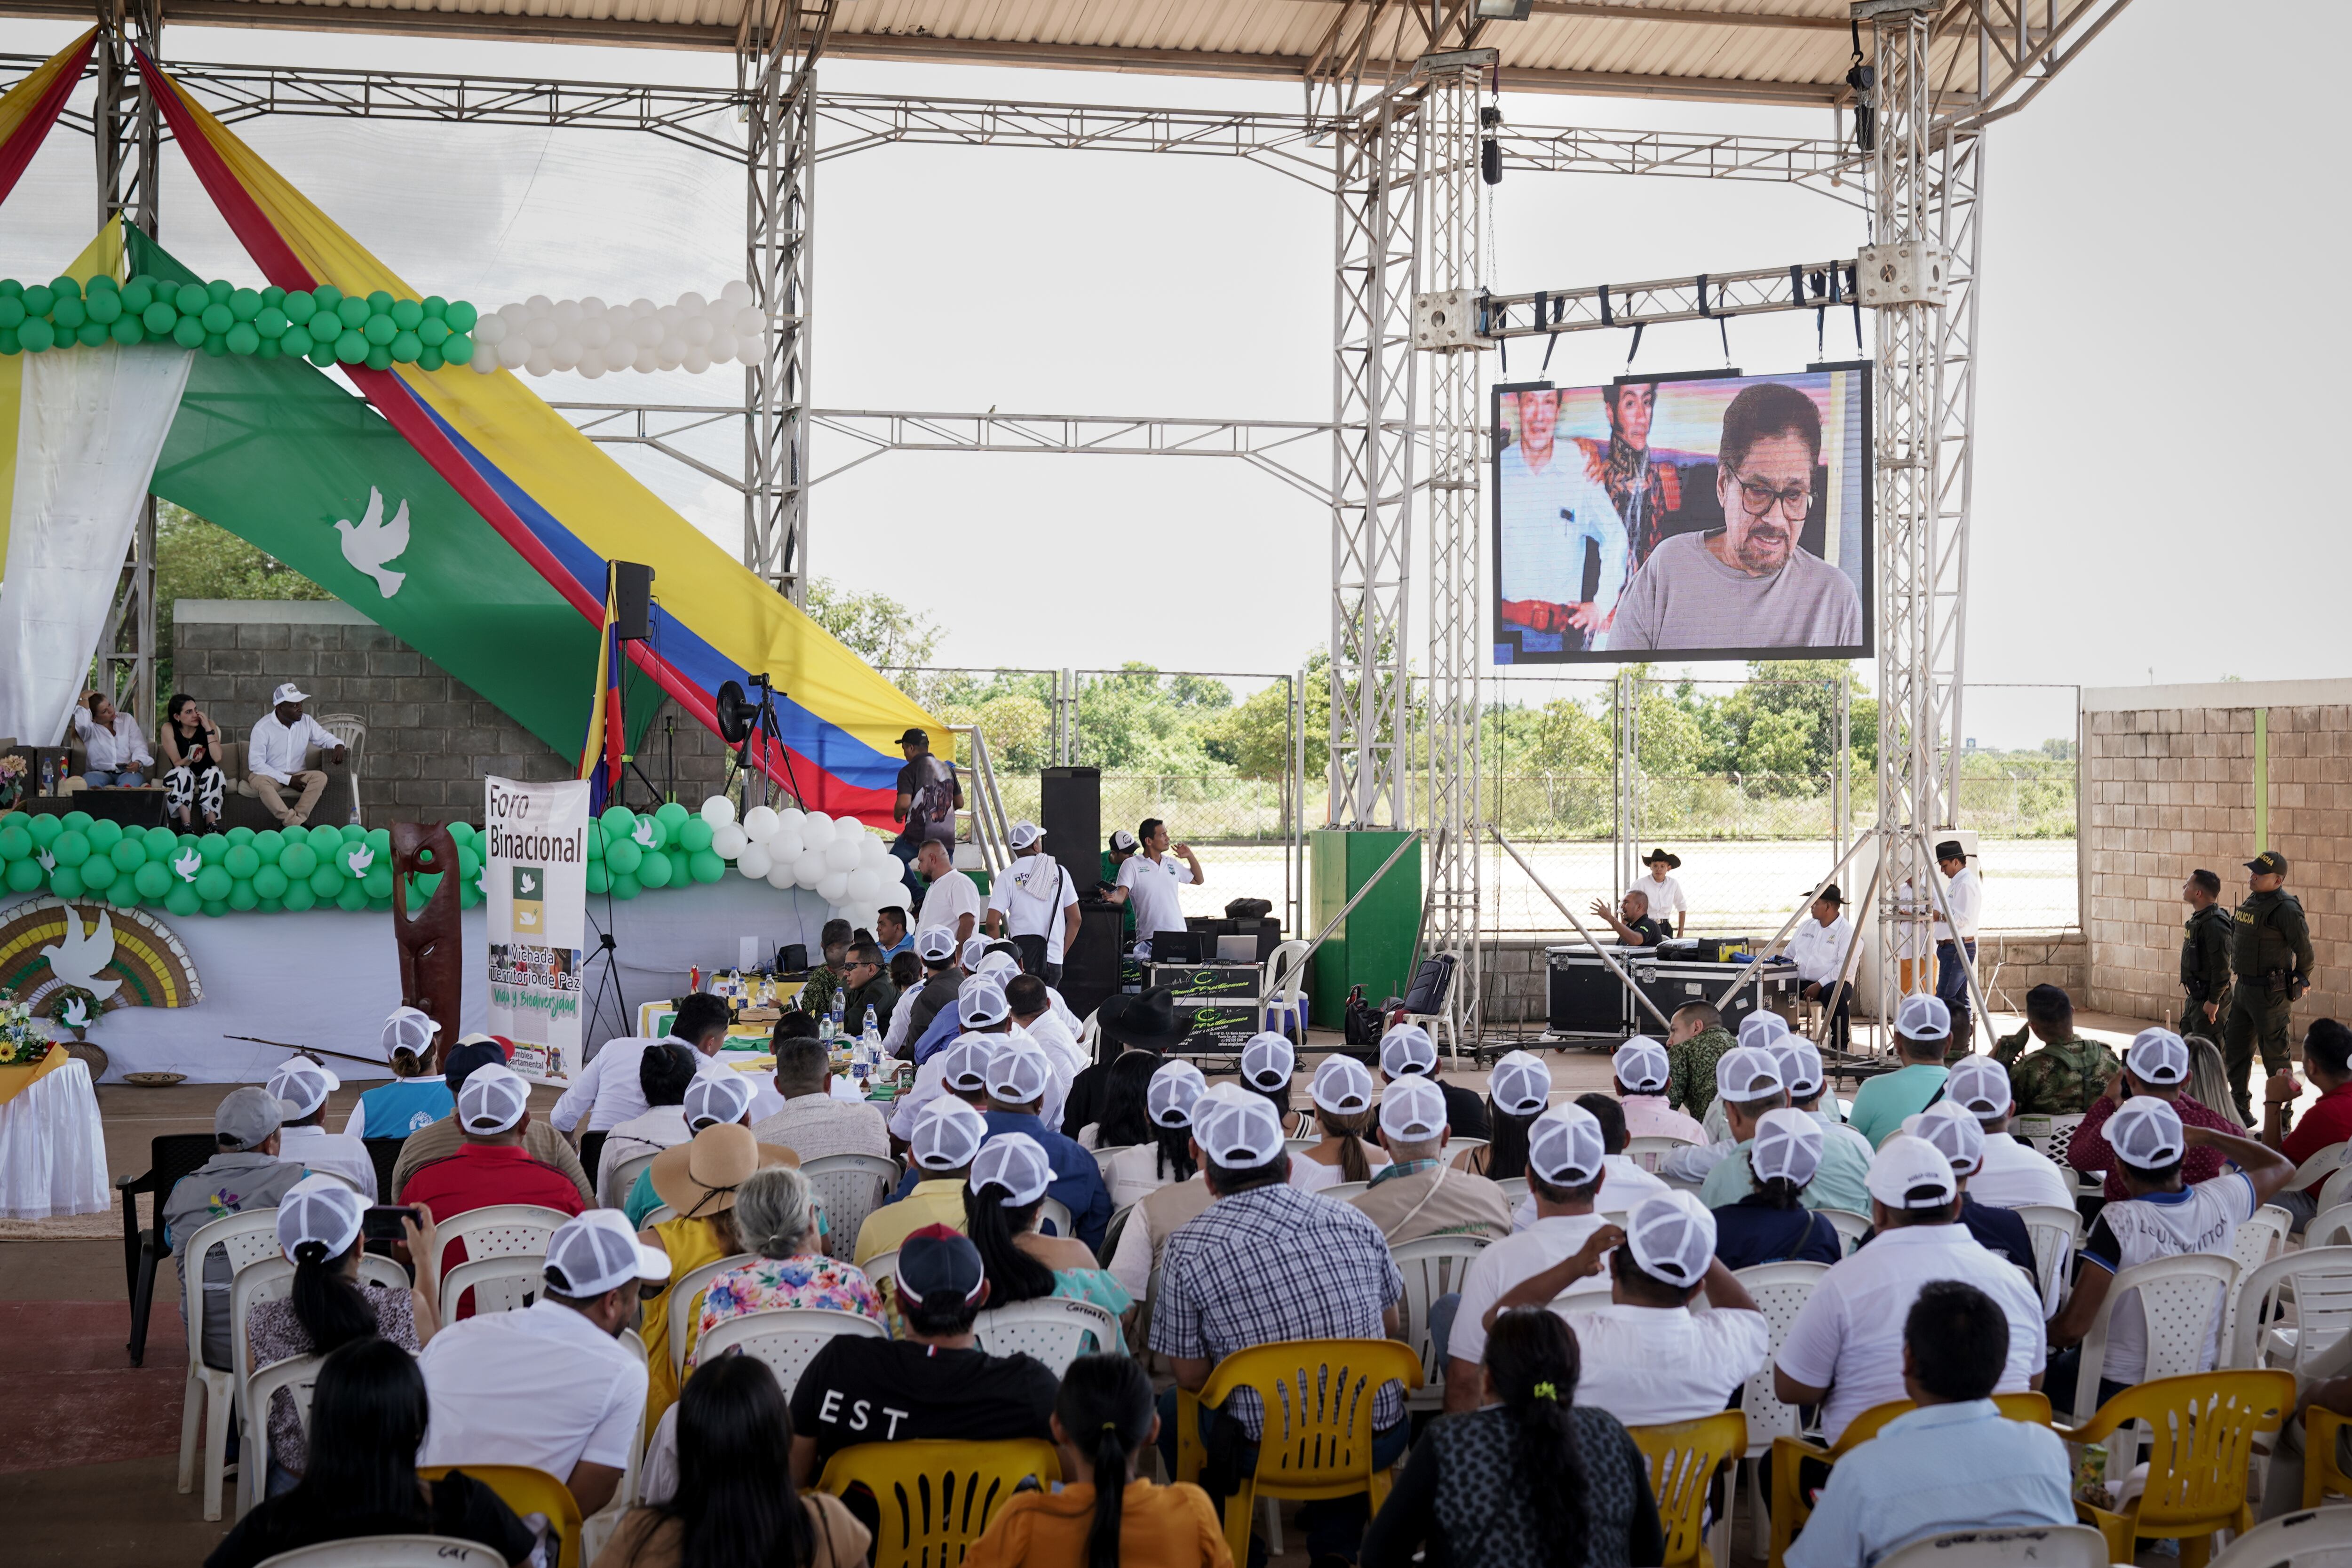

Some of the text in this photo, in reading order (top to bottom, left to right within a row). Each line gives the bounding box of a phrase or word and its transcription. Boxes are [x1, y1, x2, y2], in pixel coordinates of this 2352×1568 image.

[491, 784, 529, 819] Foro
[491, 824, 581, 862] Binacional
[2258, 853, 2274, 866] LICIA
[511, 947, 554, 964] Vichada
[490, 965, 580, 988] Territorio de Paz
[494, 988, 576, 1018] Vida y Biodiversidad
[511, 1058, 544, 1069] artamental
[513, 1051, 533, 1060] amblea
[819, 1389, 909, 1441] EST
